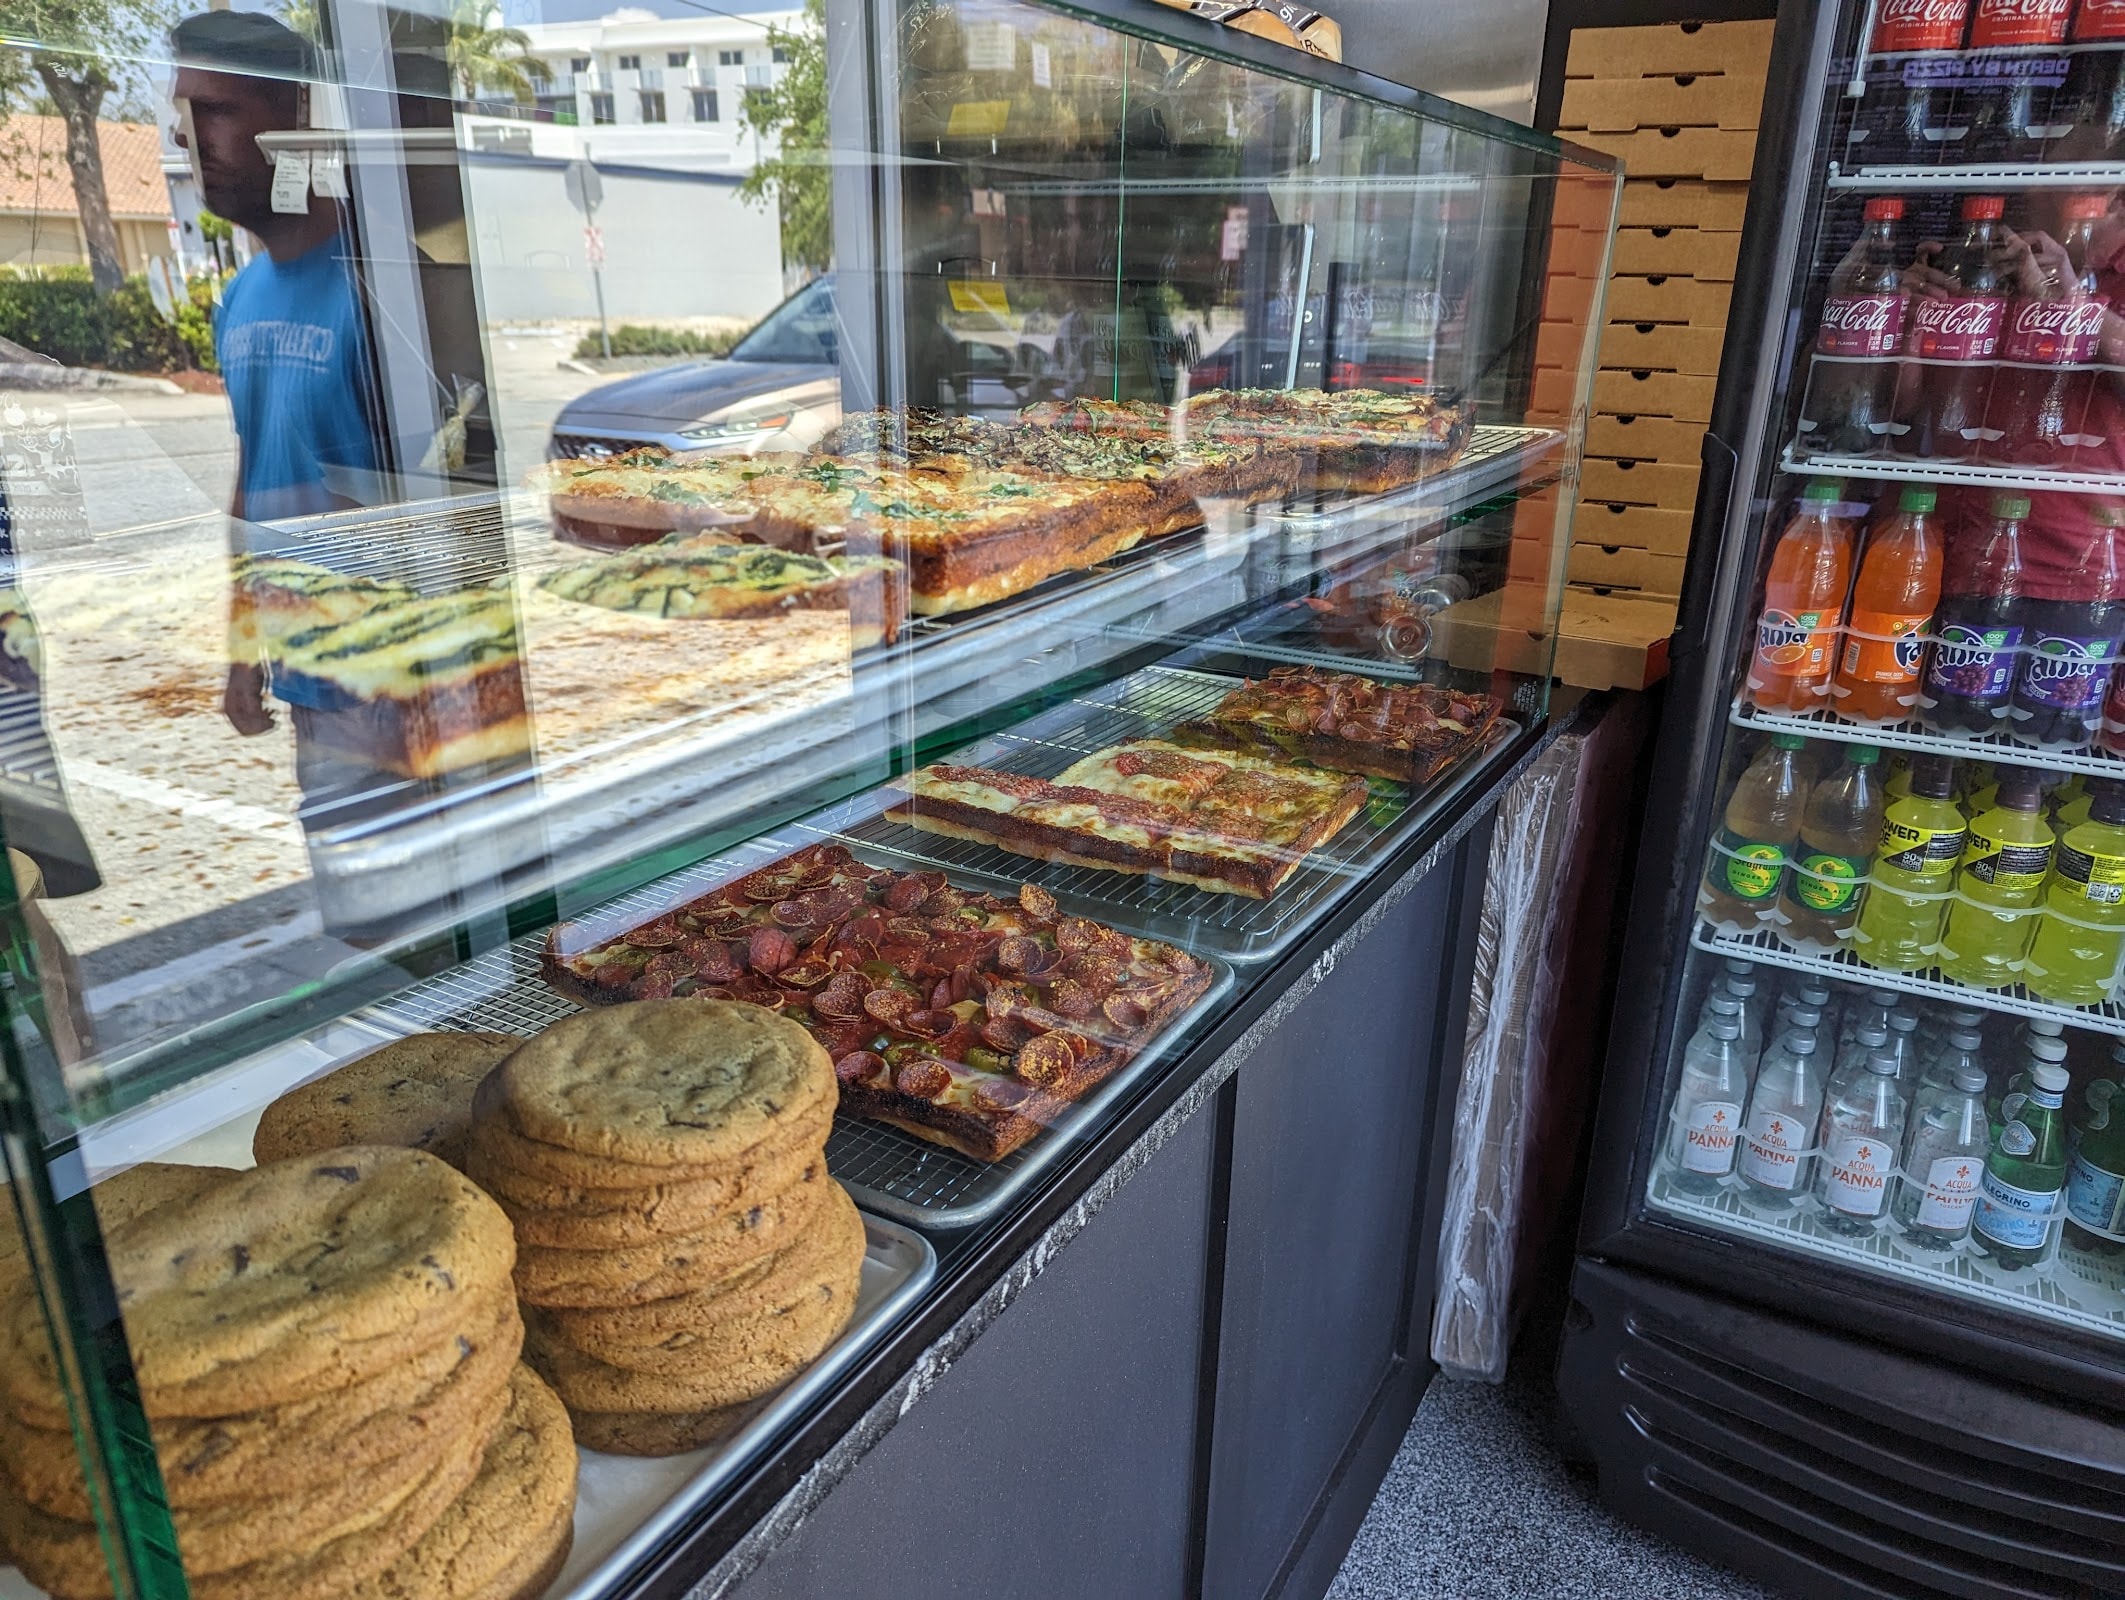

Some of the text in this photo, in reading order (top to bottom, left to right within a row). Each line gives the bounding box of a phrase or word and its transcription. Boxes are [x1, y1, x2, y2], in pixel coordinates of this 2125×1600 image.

[1931, 301, 1955, 309] Cherry
[1976, 861, 1995, 873] 50%
[1732, 869, 1762, 881] GINGER
[1801, 879, 1830, 893] GINGER
[1704, 1124, 1729, 1133] ACQUA
[1688, 1130, 1734, 1148] PANNA
[1761, 1132, 1788, 1148] ACQUA
[1848, 1160, 1876, 1173] ACQUA
[1832, 1166, 1883, 1188] PANNA
[1946, 1180, 1973, 1189] ACQUA
